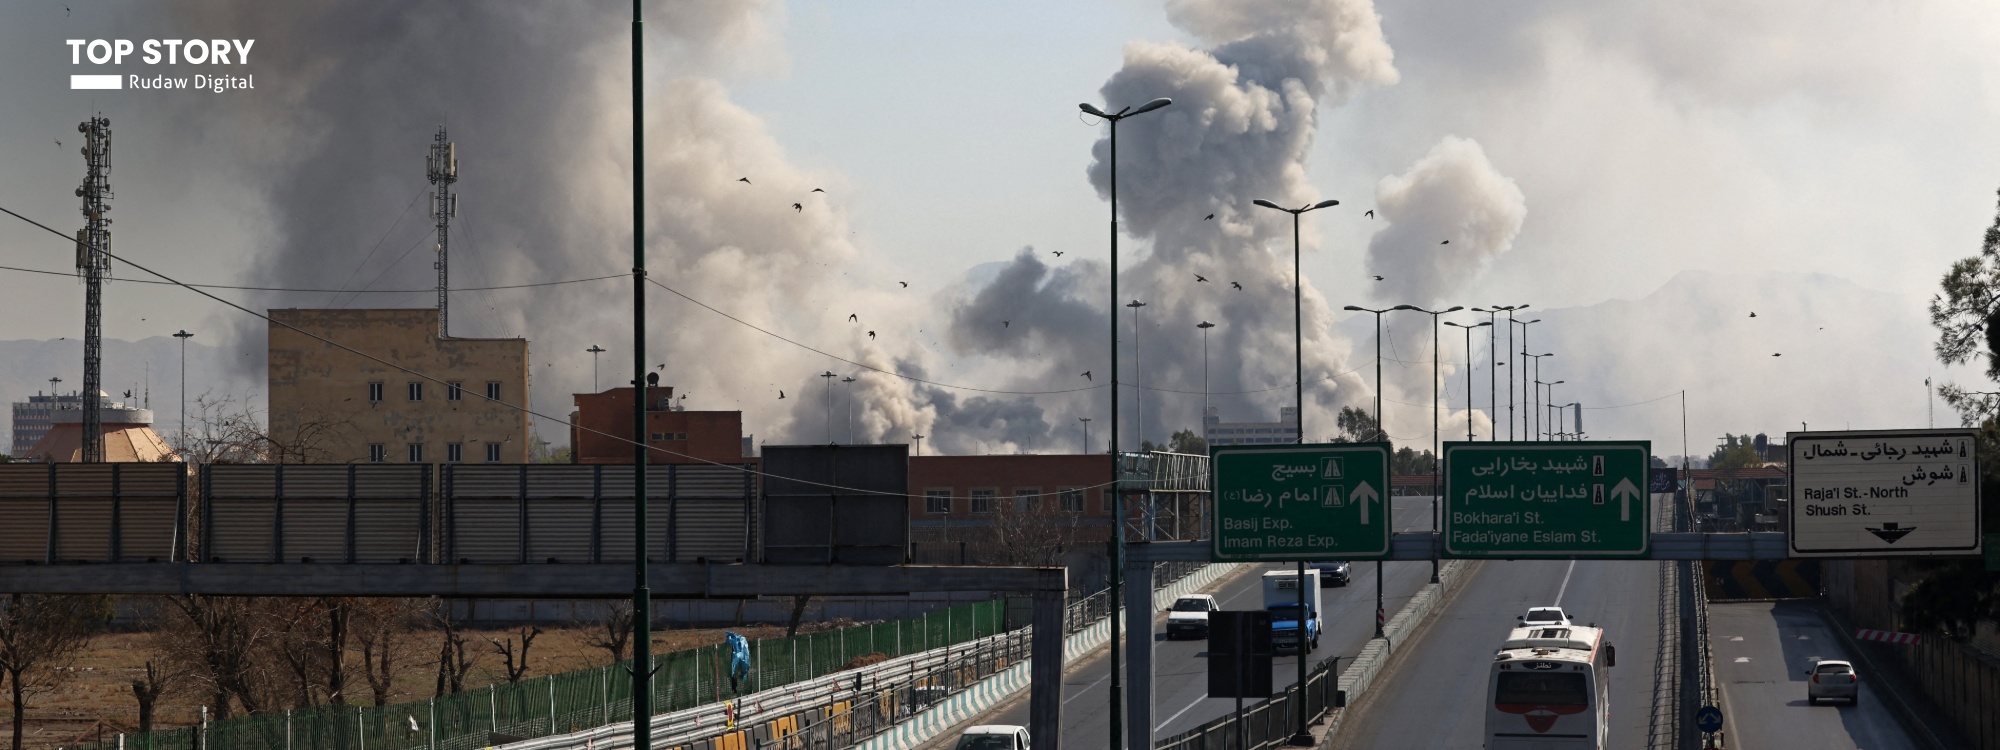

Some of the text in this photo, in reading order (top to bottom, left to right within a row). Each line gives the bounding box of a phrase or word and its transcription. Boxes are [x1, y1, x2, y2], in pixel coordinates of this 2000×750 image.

[1902, 465, 1953, 486] شوش
[1279, 487, 1318, 508] امام
[1465, 484, 1515, 505] اسلام
[1804, 487, 1840, 501] Raja'i
[1806, 503, 1871, 516] Shush St.
[1224, 517, 1293, 532] Basij Exp.
[1453, 512, 1544, 524] Bokhara'i St.
[1224, 535, 1338, 549] Imam Reza Exp.
[1453, 530, 1601, 546] Fada'iyane Eslam St.
